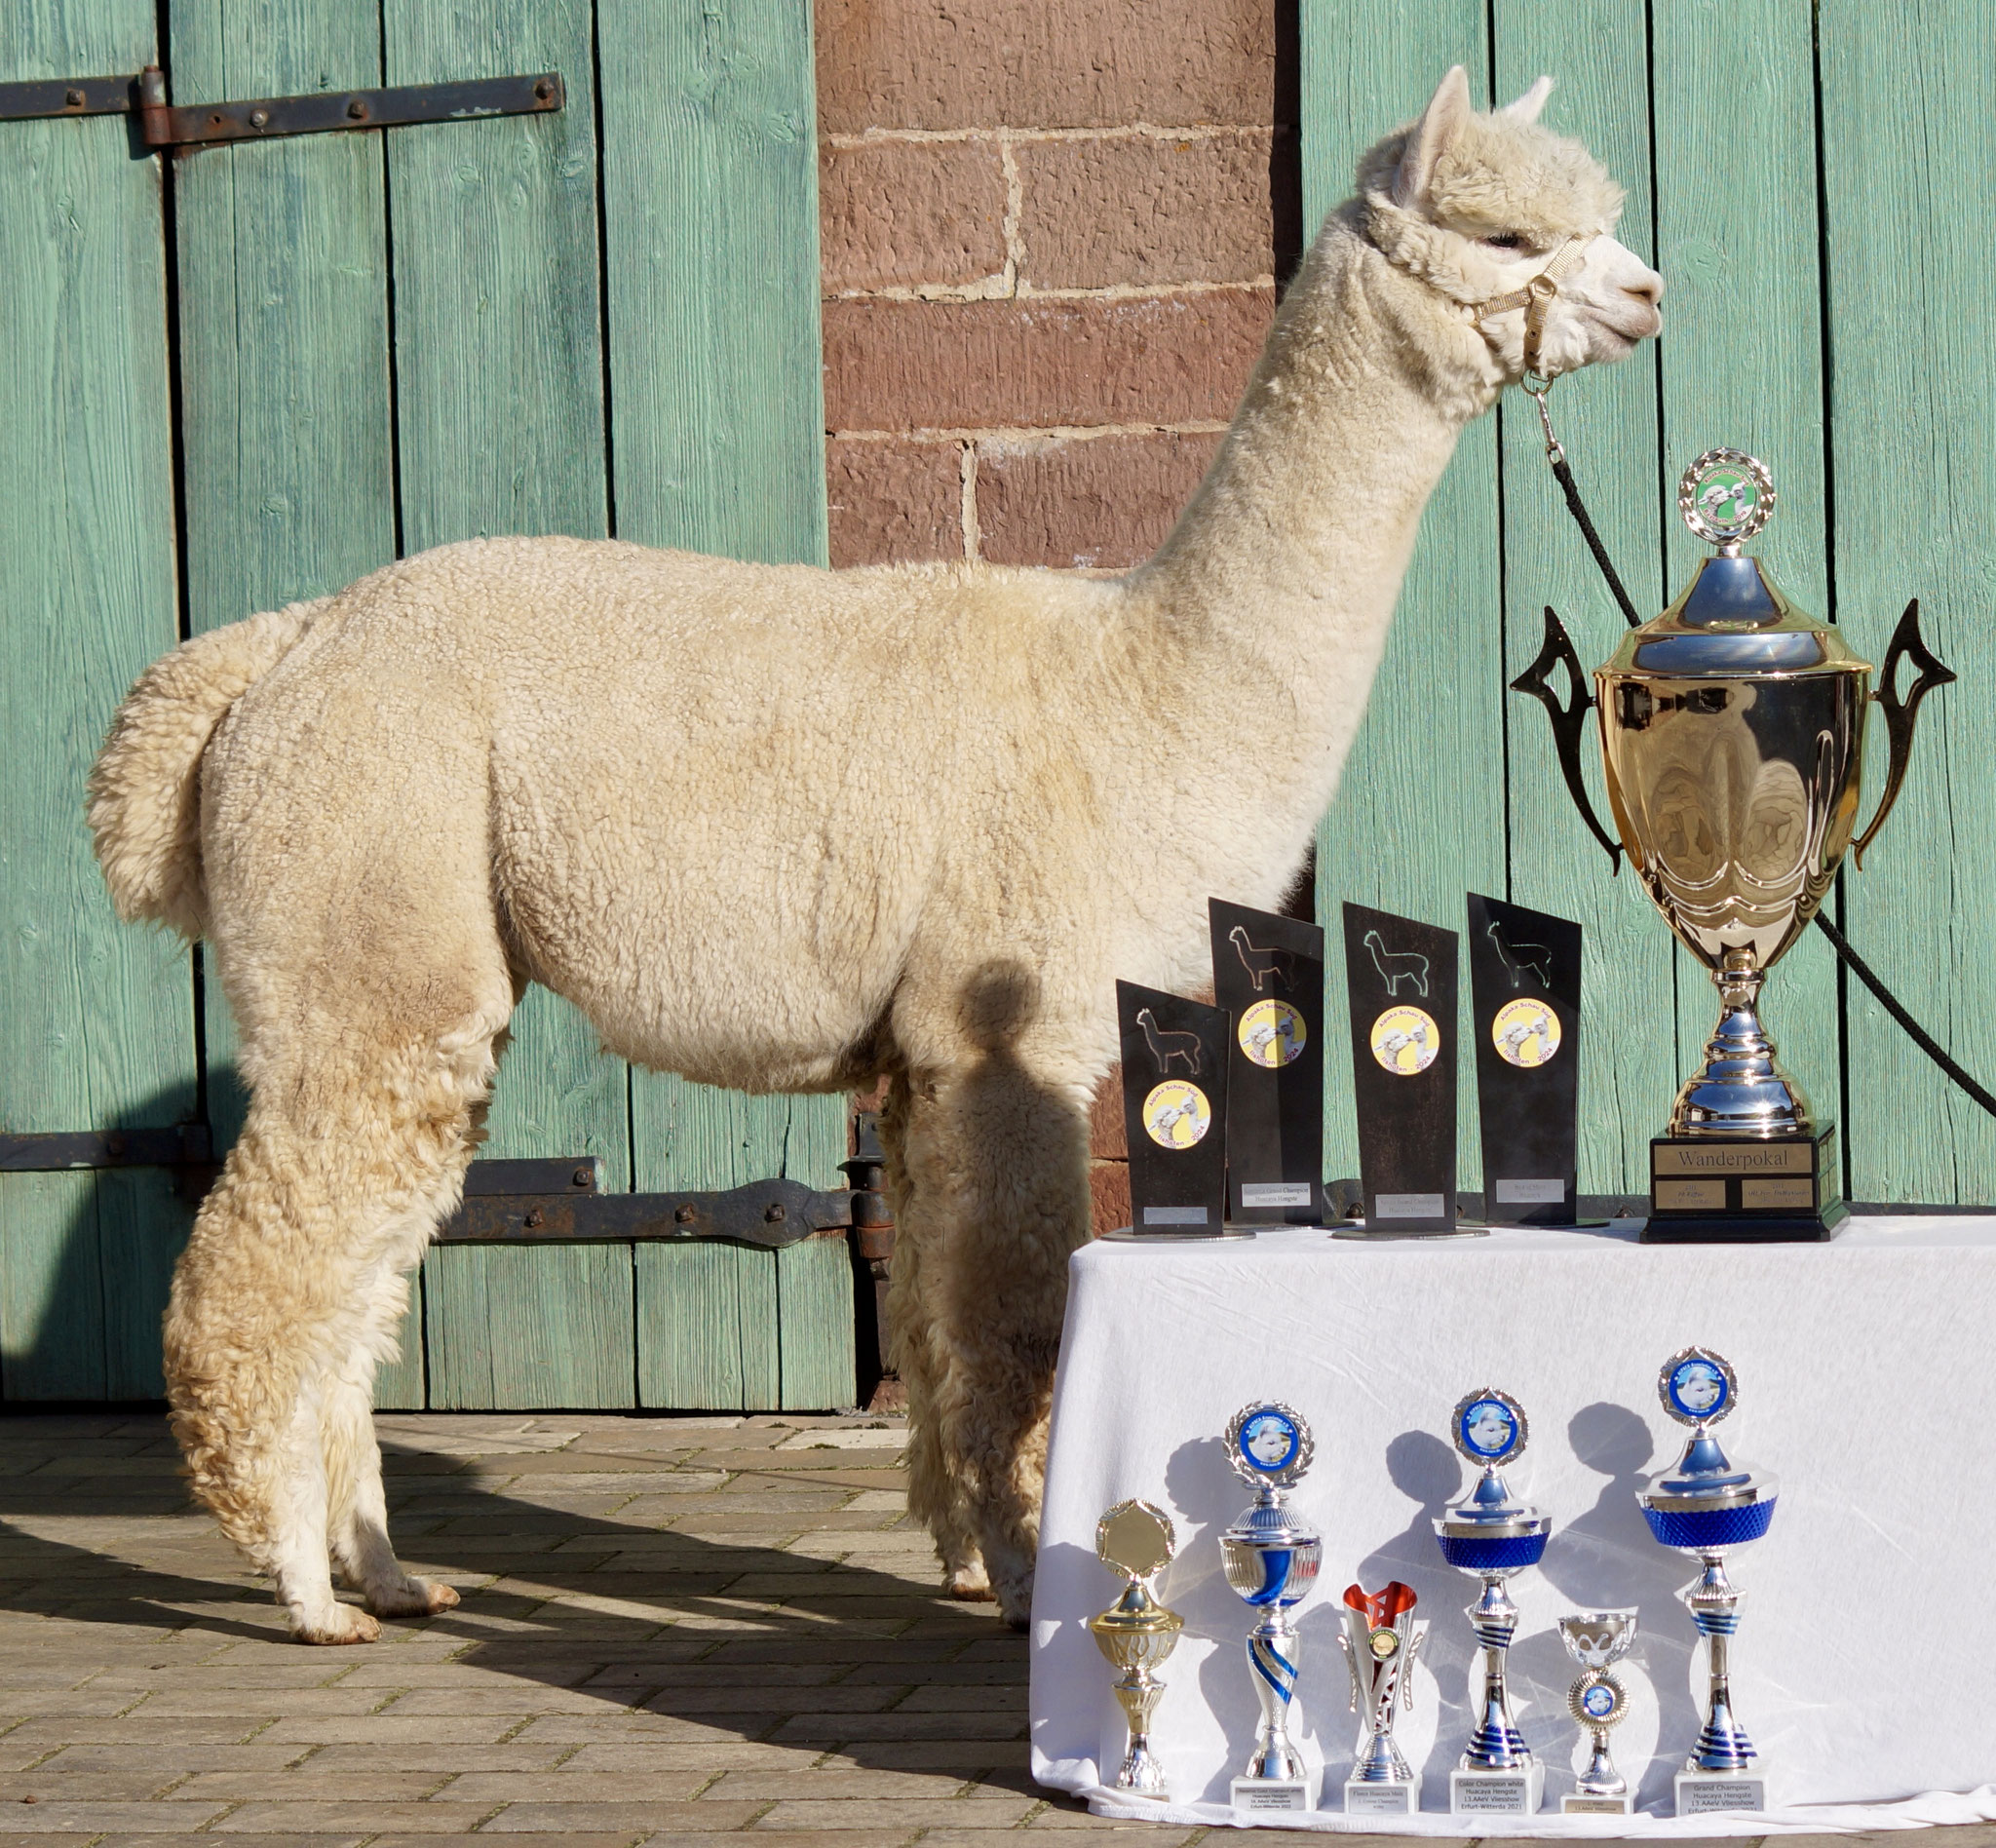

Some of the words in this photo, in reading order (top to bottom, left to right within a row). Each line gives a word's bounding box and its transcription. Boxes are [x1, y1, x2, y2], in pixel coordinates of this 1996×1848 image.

[1246, 1006, 1263, 1021] Alpaka
[1379, 1013, 1397, 1027] Alpaka
[1500, 1005, 1518, 1020] Alpaka
[1284, 1047, 1299, 1061] 2024
[1537, 1047, 1553, 1061] 2024
[1415, 1055, 1431, 1069] 2024
[1148, 1089, 1165, 1106] Alpaka
[1191, 1125, 1205, 1141] 2024
[1678, 1150, 1787, 1170] Wanderpokal
